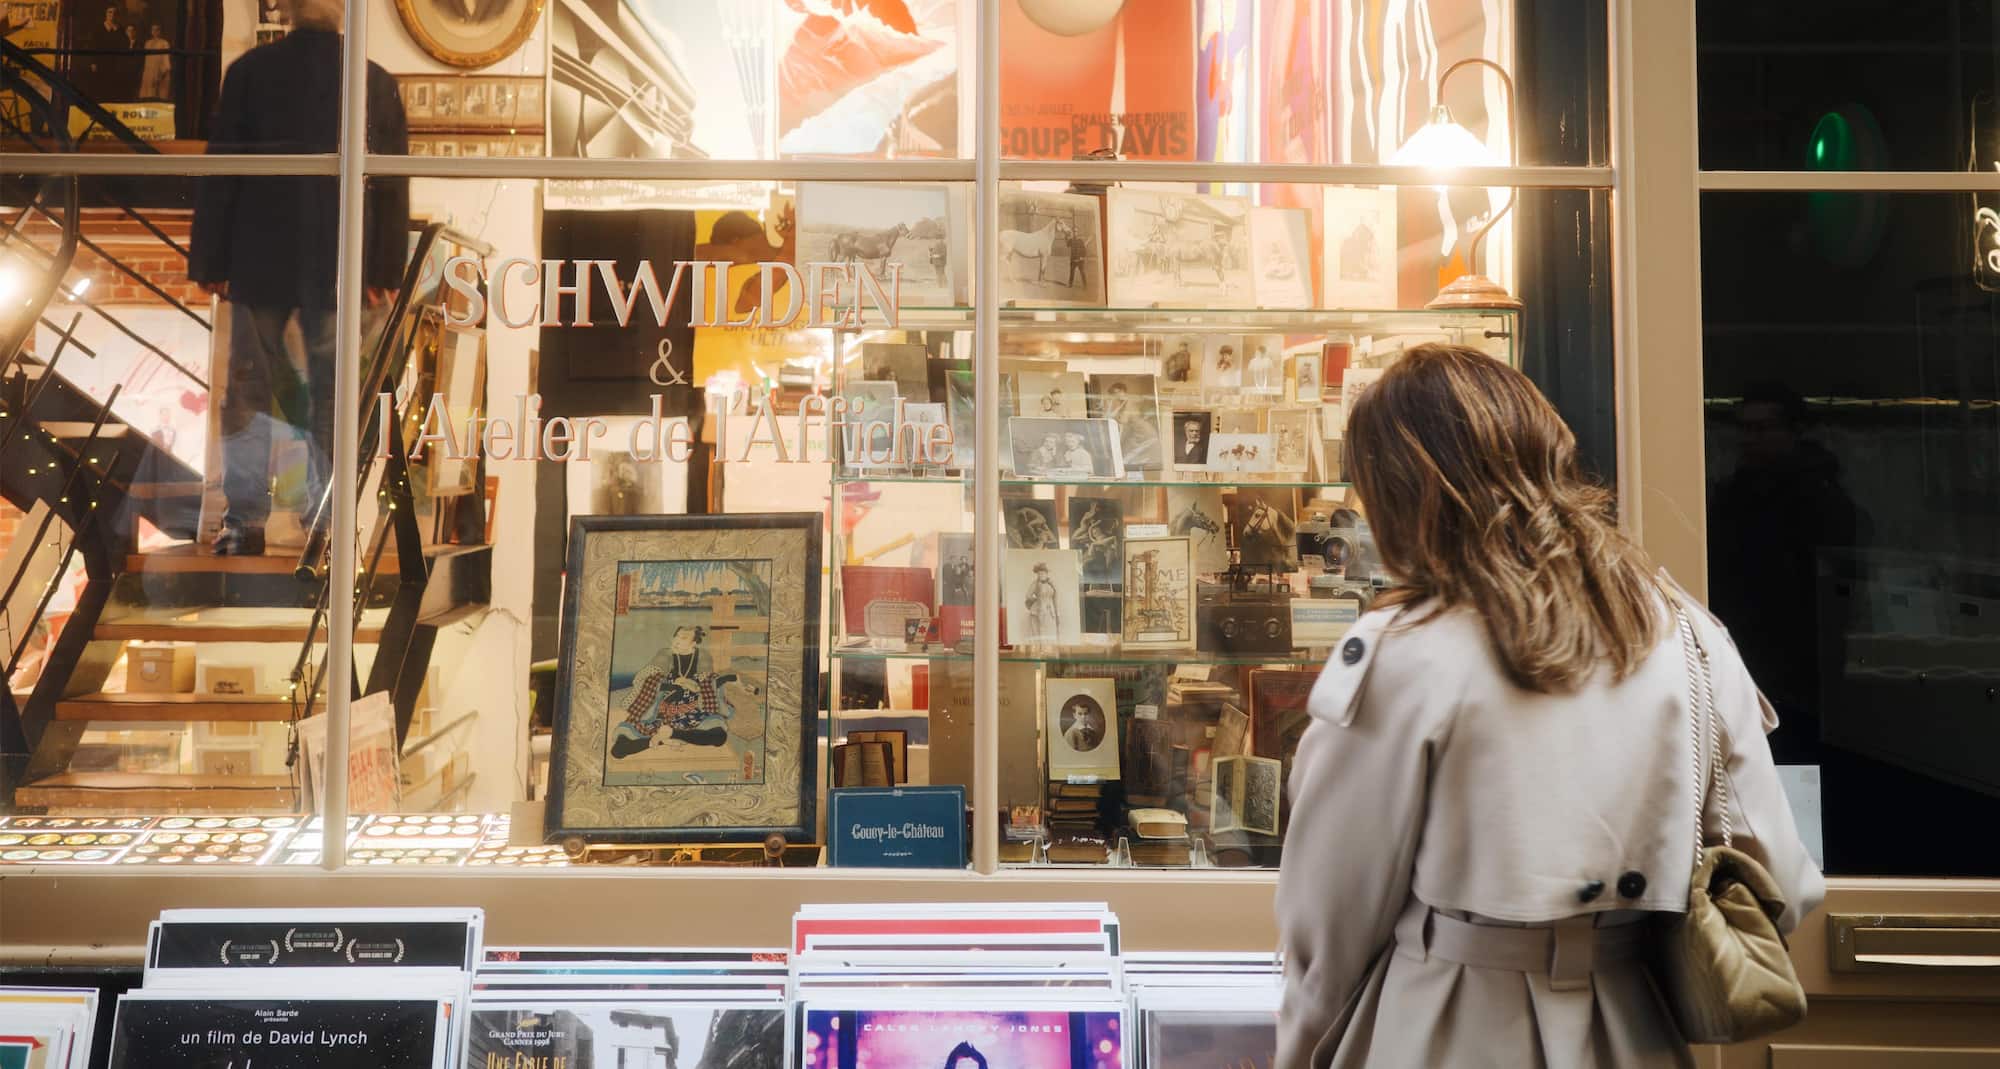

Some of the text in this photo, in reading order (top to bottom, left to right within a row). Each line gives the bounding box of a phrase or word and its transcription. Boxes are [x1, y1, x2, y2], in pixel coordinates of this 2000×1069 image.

[1000, 124, 1188, 157] COUPE DAVIS
[442, 257, 905, 329] SCHWILDEN
[648, 338, 689, 386] &
[376, 385, 956, 466] l'Atelier de l'Affiche
[254, 1009, 299, 1017] Alain Sarde
[489, 1030, 516, 1039] GRAND
[517, 1030, 535, 1039] PRIX
[536, 1031, 547, 1039] DU
[863, 1023, 919, 1032] CALEB
[1008, 1025, 1063, 1033] JONES
[181, 1030, 368, 1048] un film de David Lynch
[503, 1038, 533, 1046] CANNES
